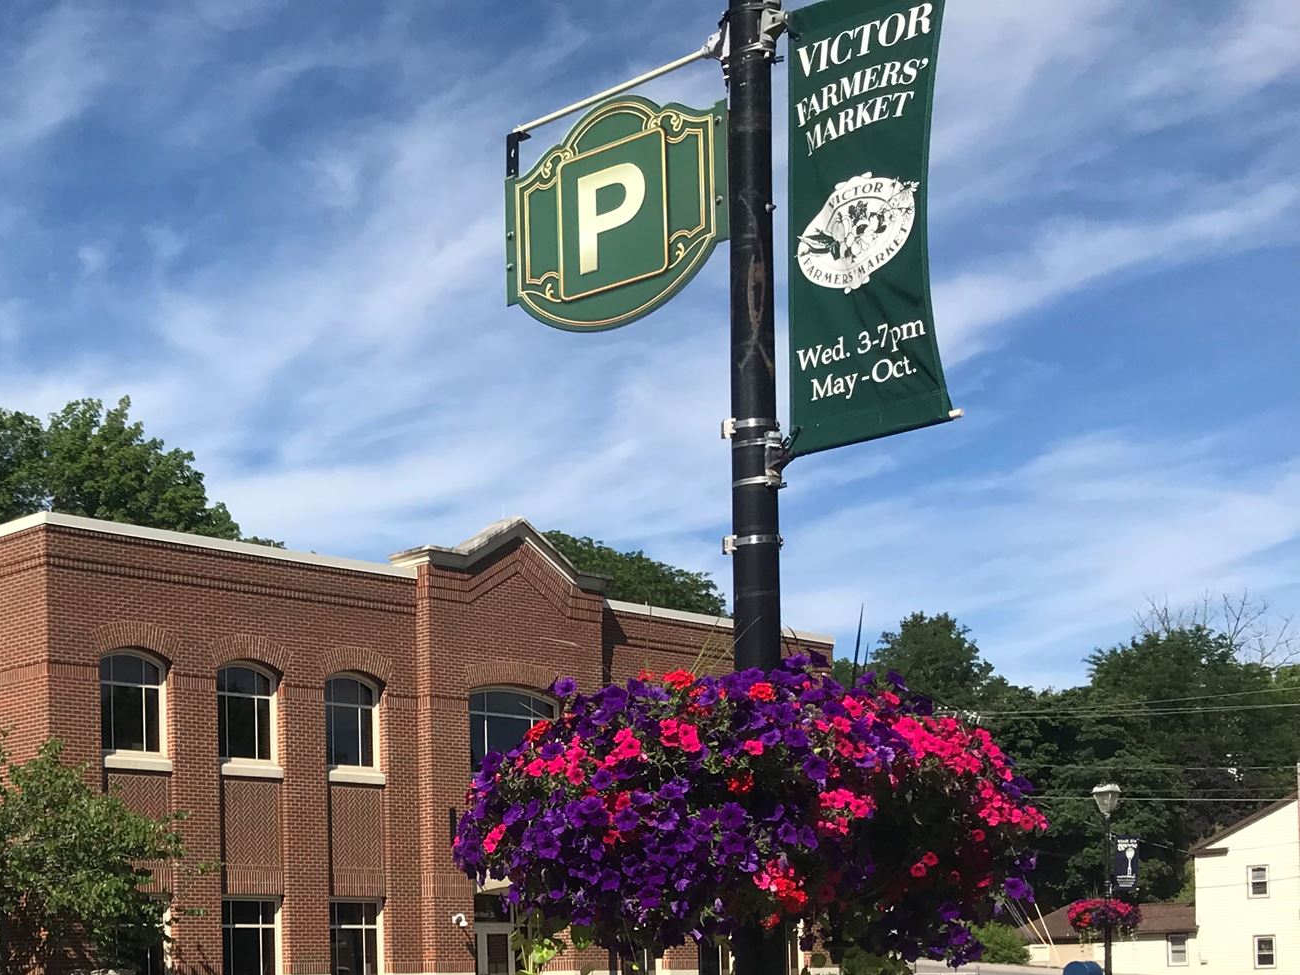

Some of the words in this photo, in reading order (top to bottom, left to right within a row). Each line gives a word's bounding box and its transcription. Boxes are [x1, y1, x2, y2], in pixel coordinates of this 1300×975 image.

[796, 2, 933, 77] VICTOR
[794, 57, 929, 128] FARMERS'
[805, 91, 915, 157] MARKET
[577, 162, 645, 276] P
[827, 181, 884, 209] VICTOR
[856, 223, 908, 279] MARKET
[796, 336, 851, 371] Wed.
[857, 319, 926, 354] 3-7pm
